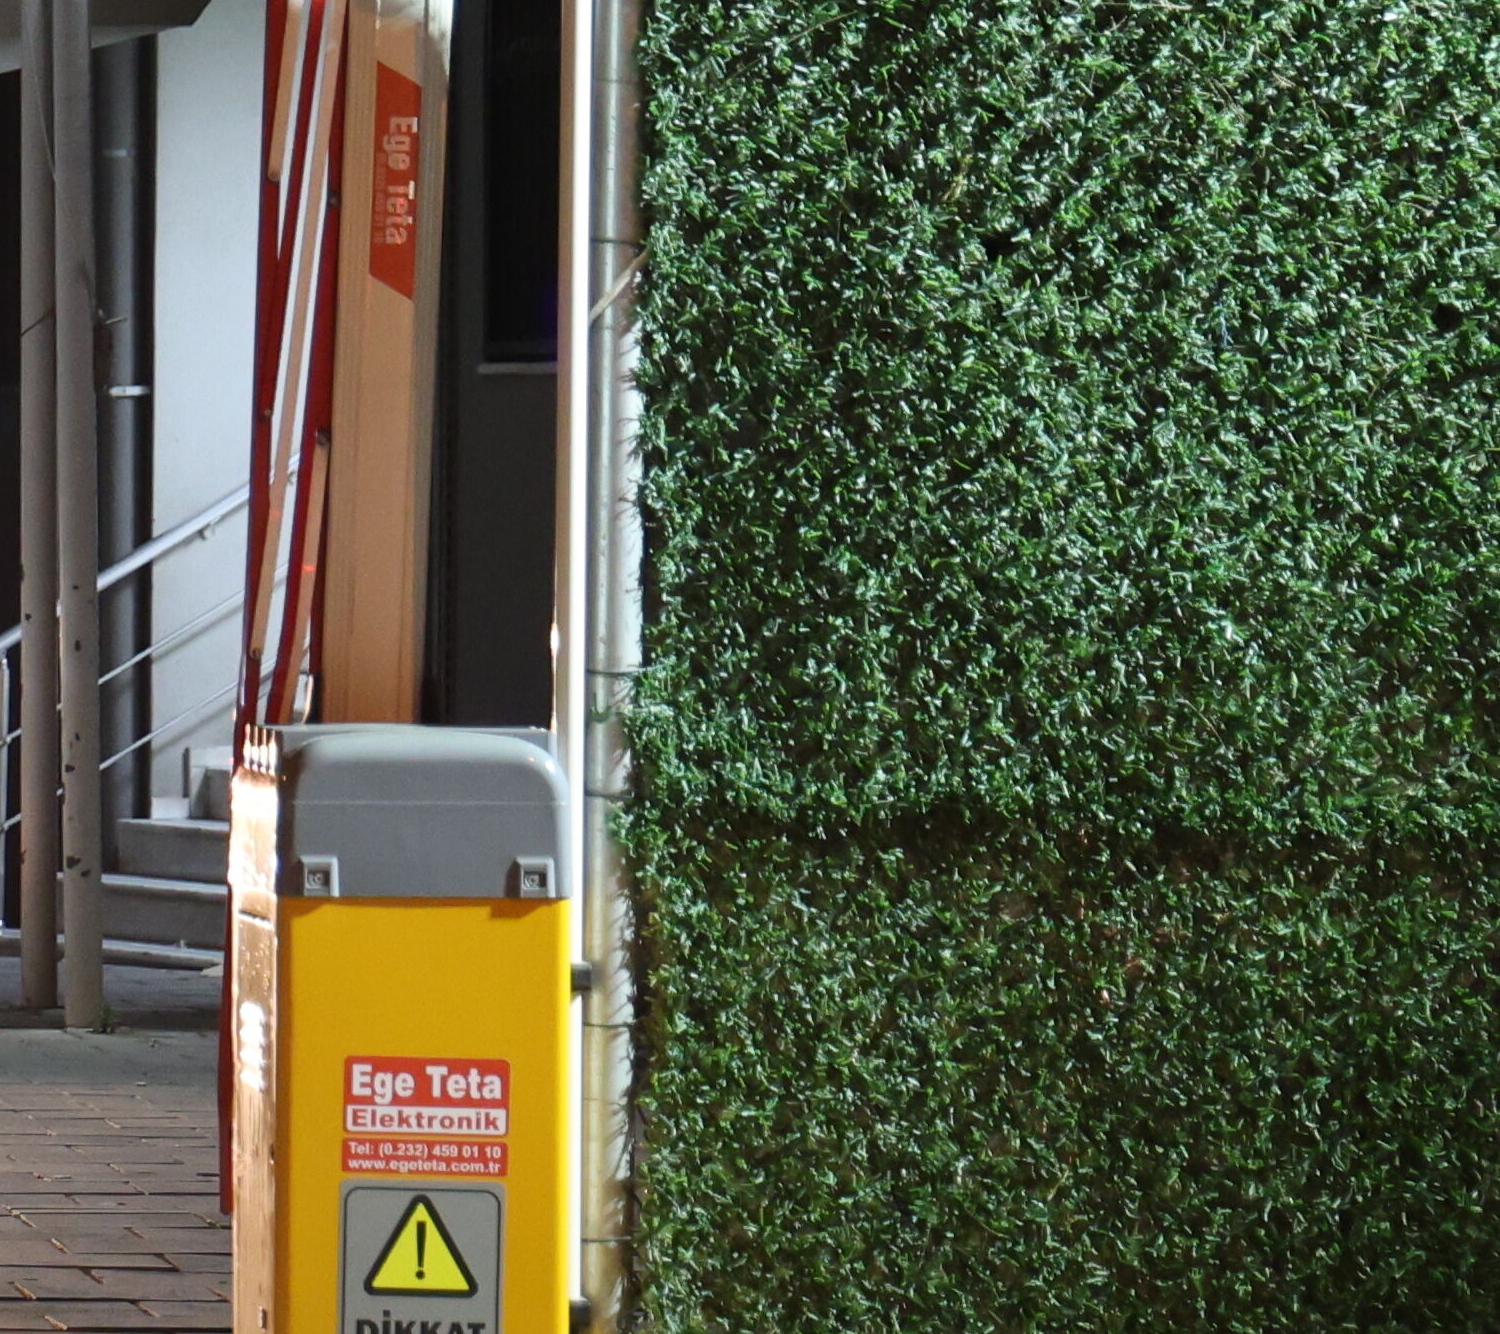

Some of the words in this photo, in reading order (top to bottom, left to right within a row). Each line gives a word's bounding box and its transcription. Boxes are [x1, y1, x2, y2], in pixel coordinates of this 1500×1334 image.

[382, 117, 418, 170] Ege
[385, 180, 415, 244] Teta
[351, 1063, 415, 1105] Ege
[425, 1065, 502, 1100] Teta
[351, 1108, 500, 1131] Elektronik
[347, 1141, 374, 1155] Tel:
[379, 1142, 428, 1158] (0.232)
[432, 1144, 458, 1157] 459
[462, 1145, 479, 1158] 01
[485, 1145, 501, 1158] 10
[347, 1159, 501, 1174] www.egeteta.com.tr
